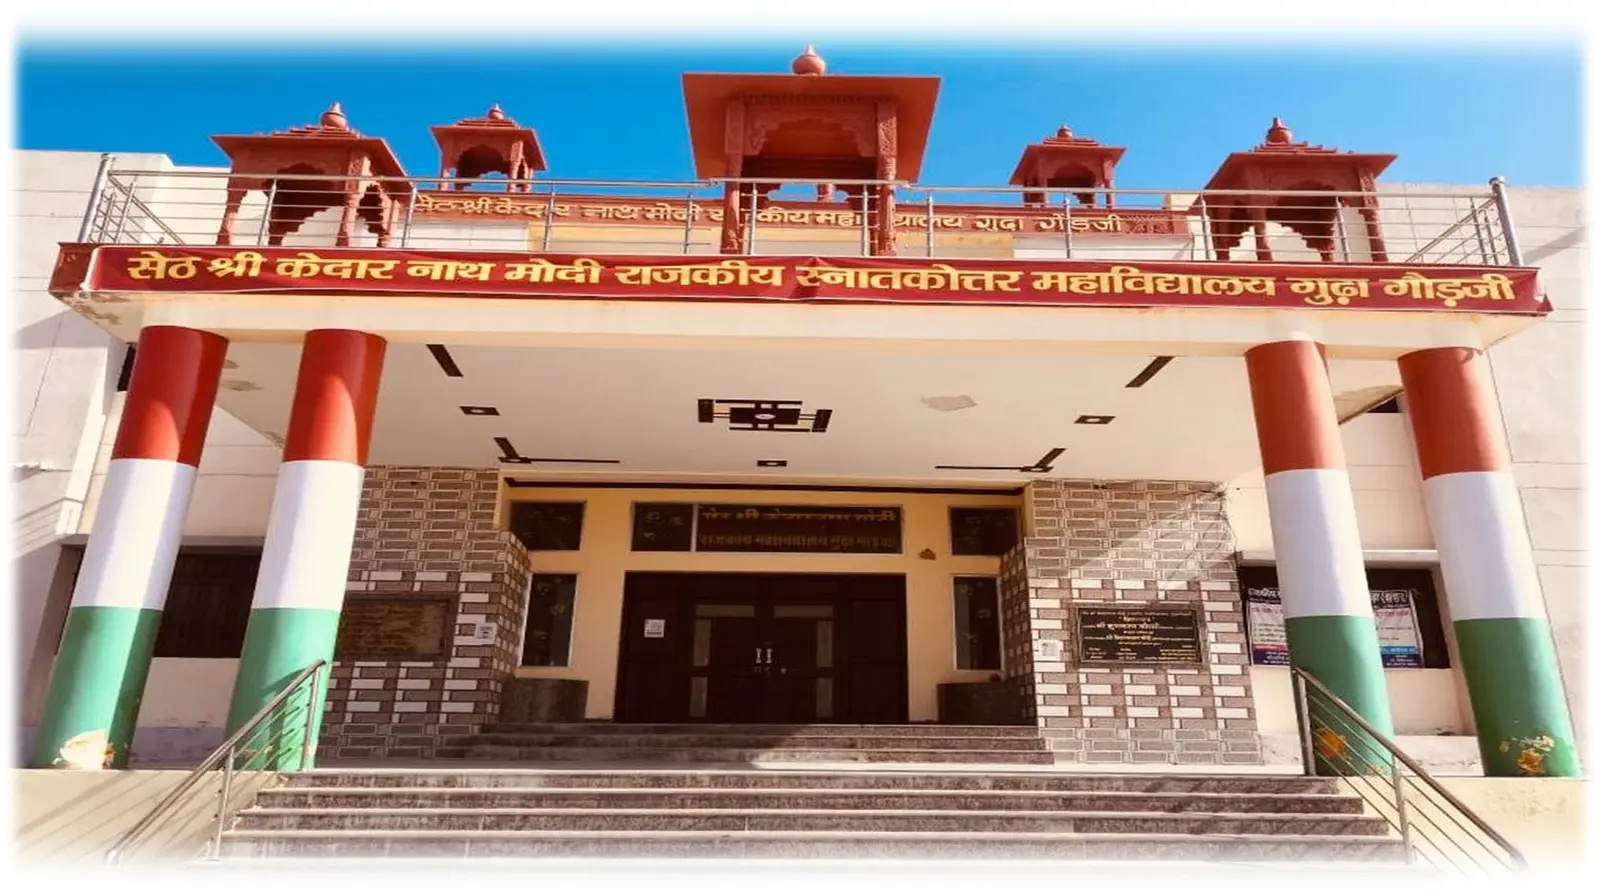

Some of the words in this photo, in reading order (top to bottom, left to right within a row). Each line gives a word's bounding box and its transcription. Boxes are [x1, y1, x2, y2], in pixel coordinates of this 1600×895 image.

[581, 204, 641, 220] नाथ
[127, 251, 200, 281] सेठ
[206, 250, 267, 279] श्री
[275, 252, 400, 281] केदार
[406, 259, 494, 282] नाथ
[503, 257, 602, 284] मोदी
[614, 260, 786, 287] राजकीय
[796, 263, 1025, 293] स्नातकोत्तर
[1031, 266, 1277, 297] महाविद्यालय
[1285, 276, 1372, 306] गुढ़ा
